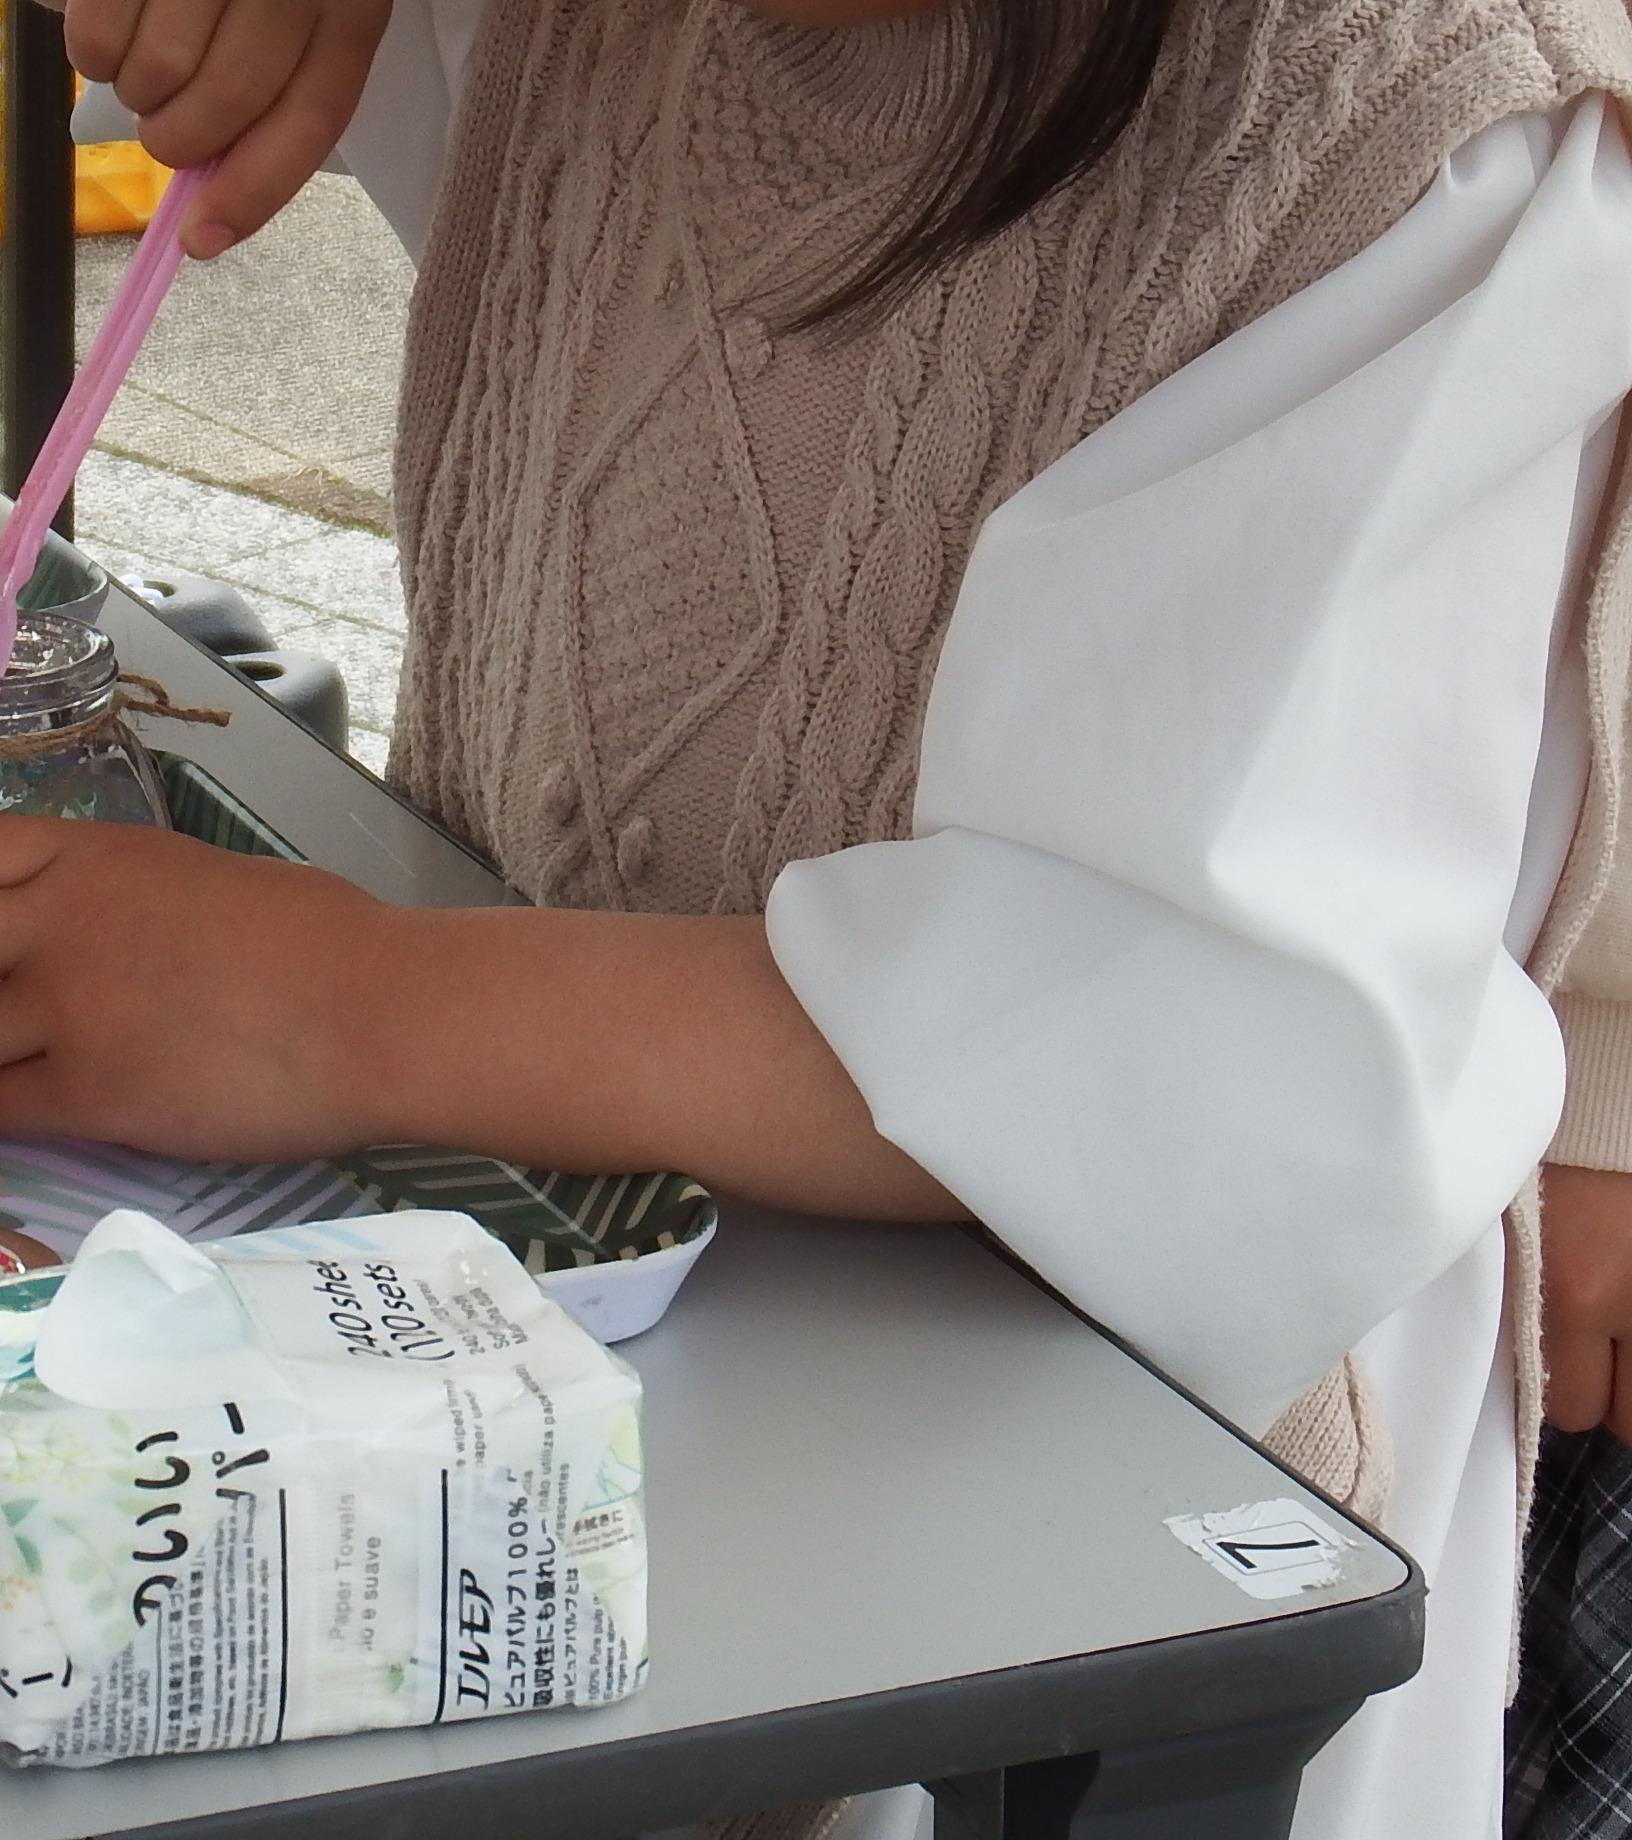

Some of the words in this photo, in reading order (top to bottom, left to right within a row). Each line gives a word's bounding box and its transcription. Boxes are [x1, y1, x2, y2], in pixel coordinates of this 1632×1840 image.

[329, 1312, 393, 1358] 240
[380, 1314, 456, 1361] (120
[451, 1409, 466, 1454] wiped
[333, 1493, 356, 1571] Towels
[363, 1536, 381, 1601] suave
[327, 1580, 352, 1641] Paper
[456, 1567, 495, 1711] エルモア
